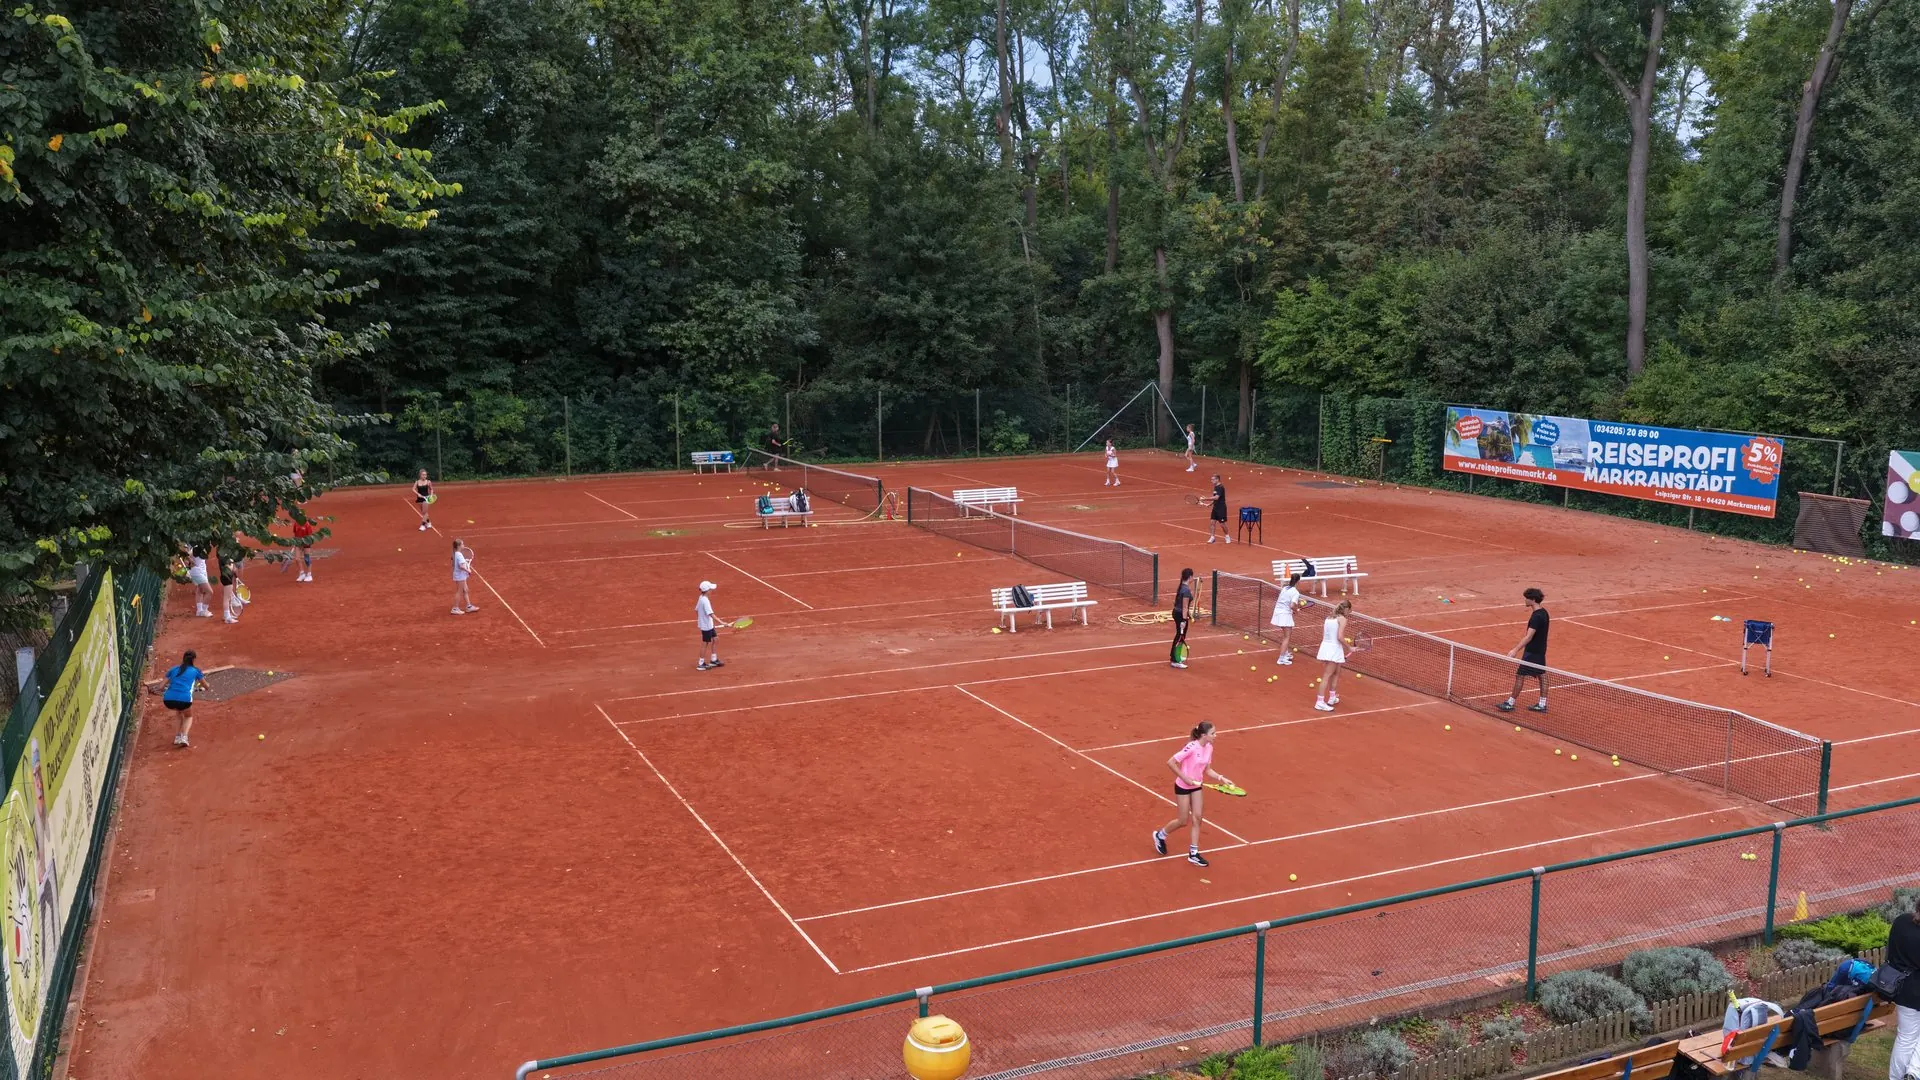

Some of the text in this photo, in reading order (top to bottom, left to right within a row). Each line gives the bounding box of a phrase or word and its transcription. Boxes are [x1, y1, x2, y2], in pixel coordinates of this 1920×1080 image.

[1540, 434, 1556, 442] Internet
[1594, 424, 1659, 439] (034205) 20 89 00
[1587, 441, 1736, 472] REISEPROFI
[1748, 443, 1777, 463] 5%
[1458, 461, 1557, 480] www.reiseprofiammarkt.de
[1583, 466, 1736, 493] MARKRANSTÄDT
[1655, 490, 1681, 500] Leipziger
[1682, 493, 1694, 501] Str.
[1706, 497, 1726, 506] 04420
[1726, 499, 1771, 512] Markranstädt
